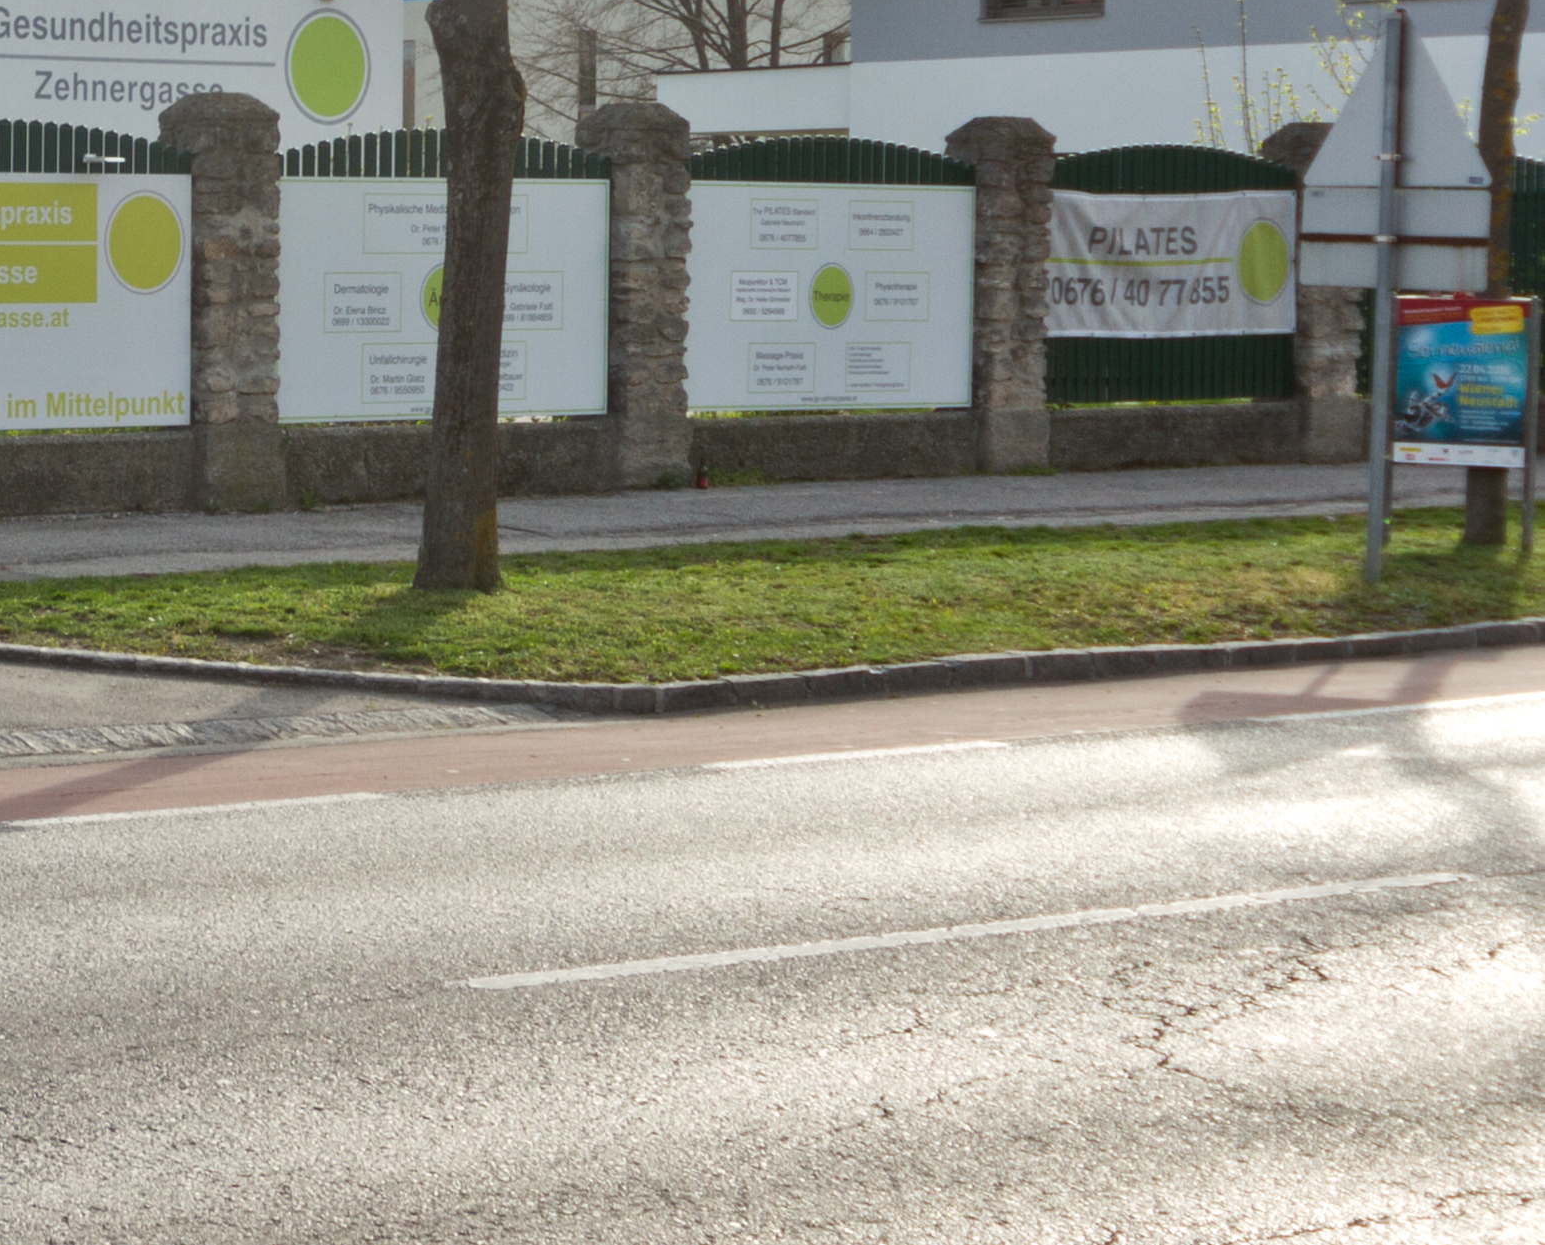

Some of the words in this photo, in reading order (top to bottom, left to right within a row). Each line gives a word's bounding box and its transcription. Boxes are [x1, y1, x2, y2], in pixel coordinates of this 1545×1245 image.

[1088, 226, 1199, 256] PILATES
[334, 283, 389, 296] Dermatologie
[813, 289, 851, 304] Therapie
[1051, 276, 1106, 307] 0676
[369, 354, 428, 367] Unfallchirurgie
[7, 393, 37, 419] im
[46, 390, 186, 422] Mittelpunkt
